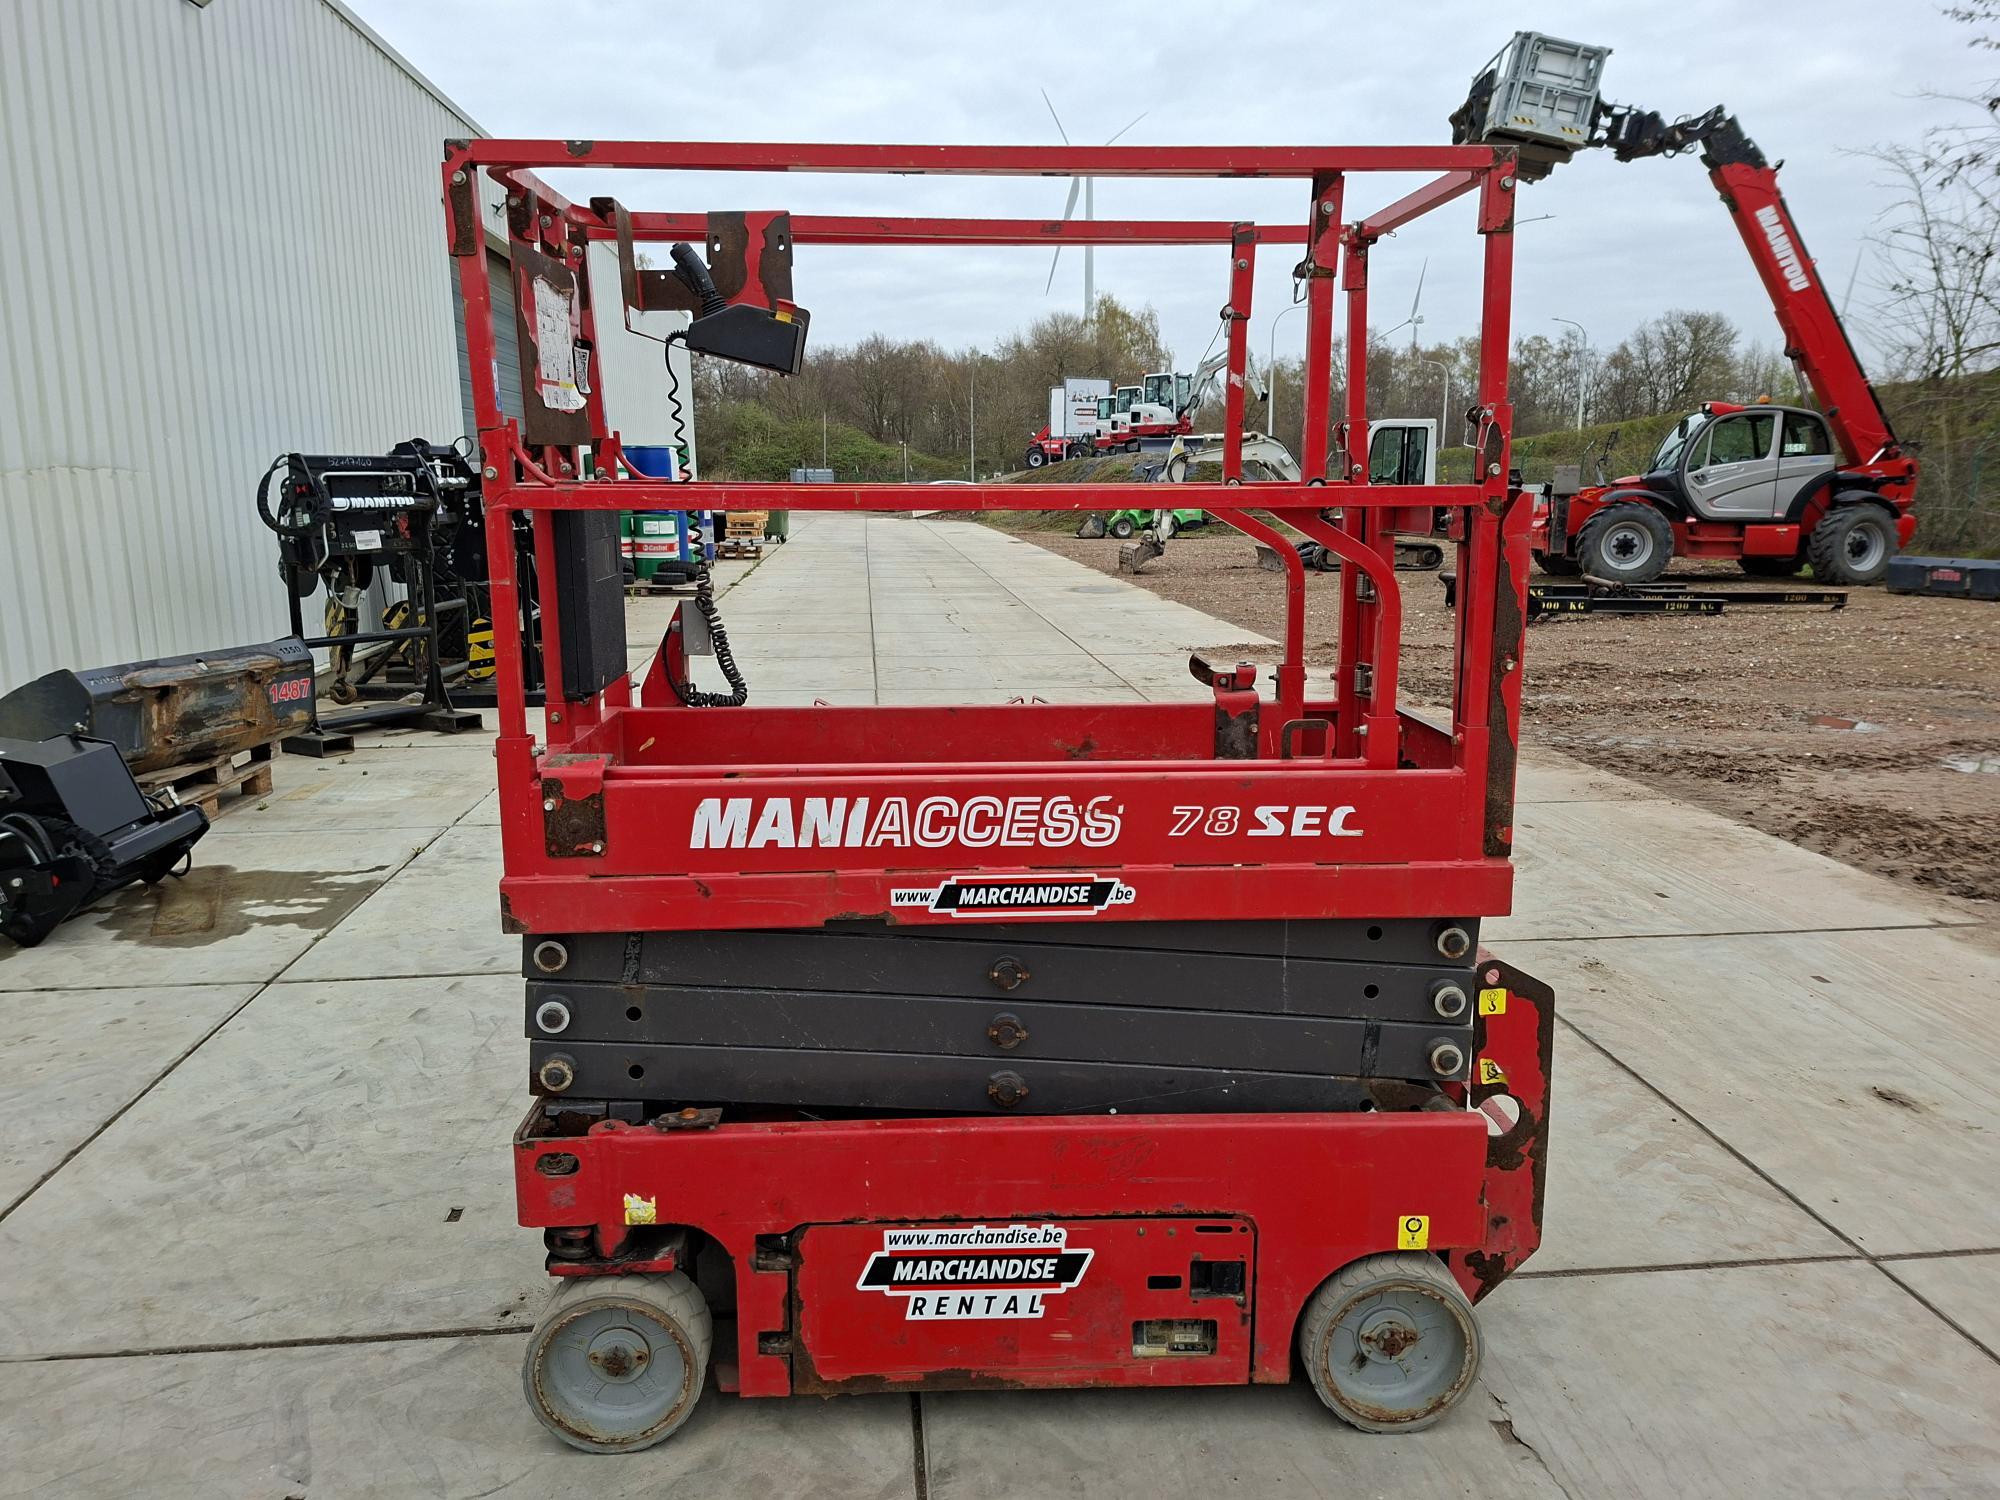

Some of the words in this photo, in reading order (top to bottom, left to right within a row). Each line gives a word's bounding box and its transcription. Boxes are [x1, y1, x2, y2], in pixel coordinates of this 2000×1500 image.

[1755, 204, 1811, 292] MANITOU
[349, 496, 415, 509] MANITOU
[1569, 601, 1585, 611] KG
[1665, 602, 1690, 610] 1200
[1700, 602, 1715, 611] KG
[270, 678, 311, 703] 1487
[1168, 805, 1240, 836] 78
[1247, 805, 1364, 837] SEC
[888, 1229, 1063, 1246] www.marchandise.be
[892, 1258, 1058, 1282] MARCHANDISE
[911, 1295, 1041, 1316] RENTAL
